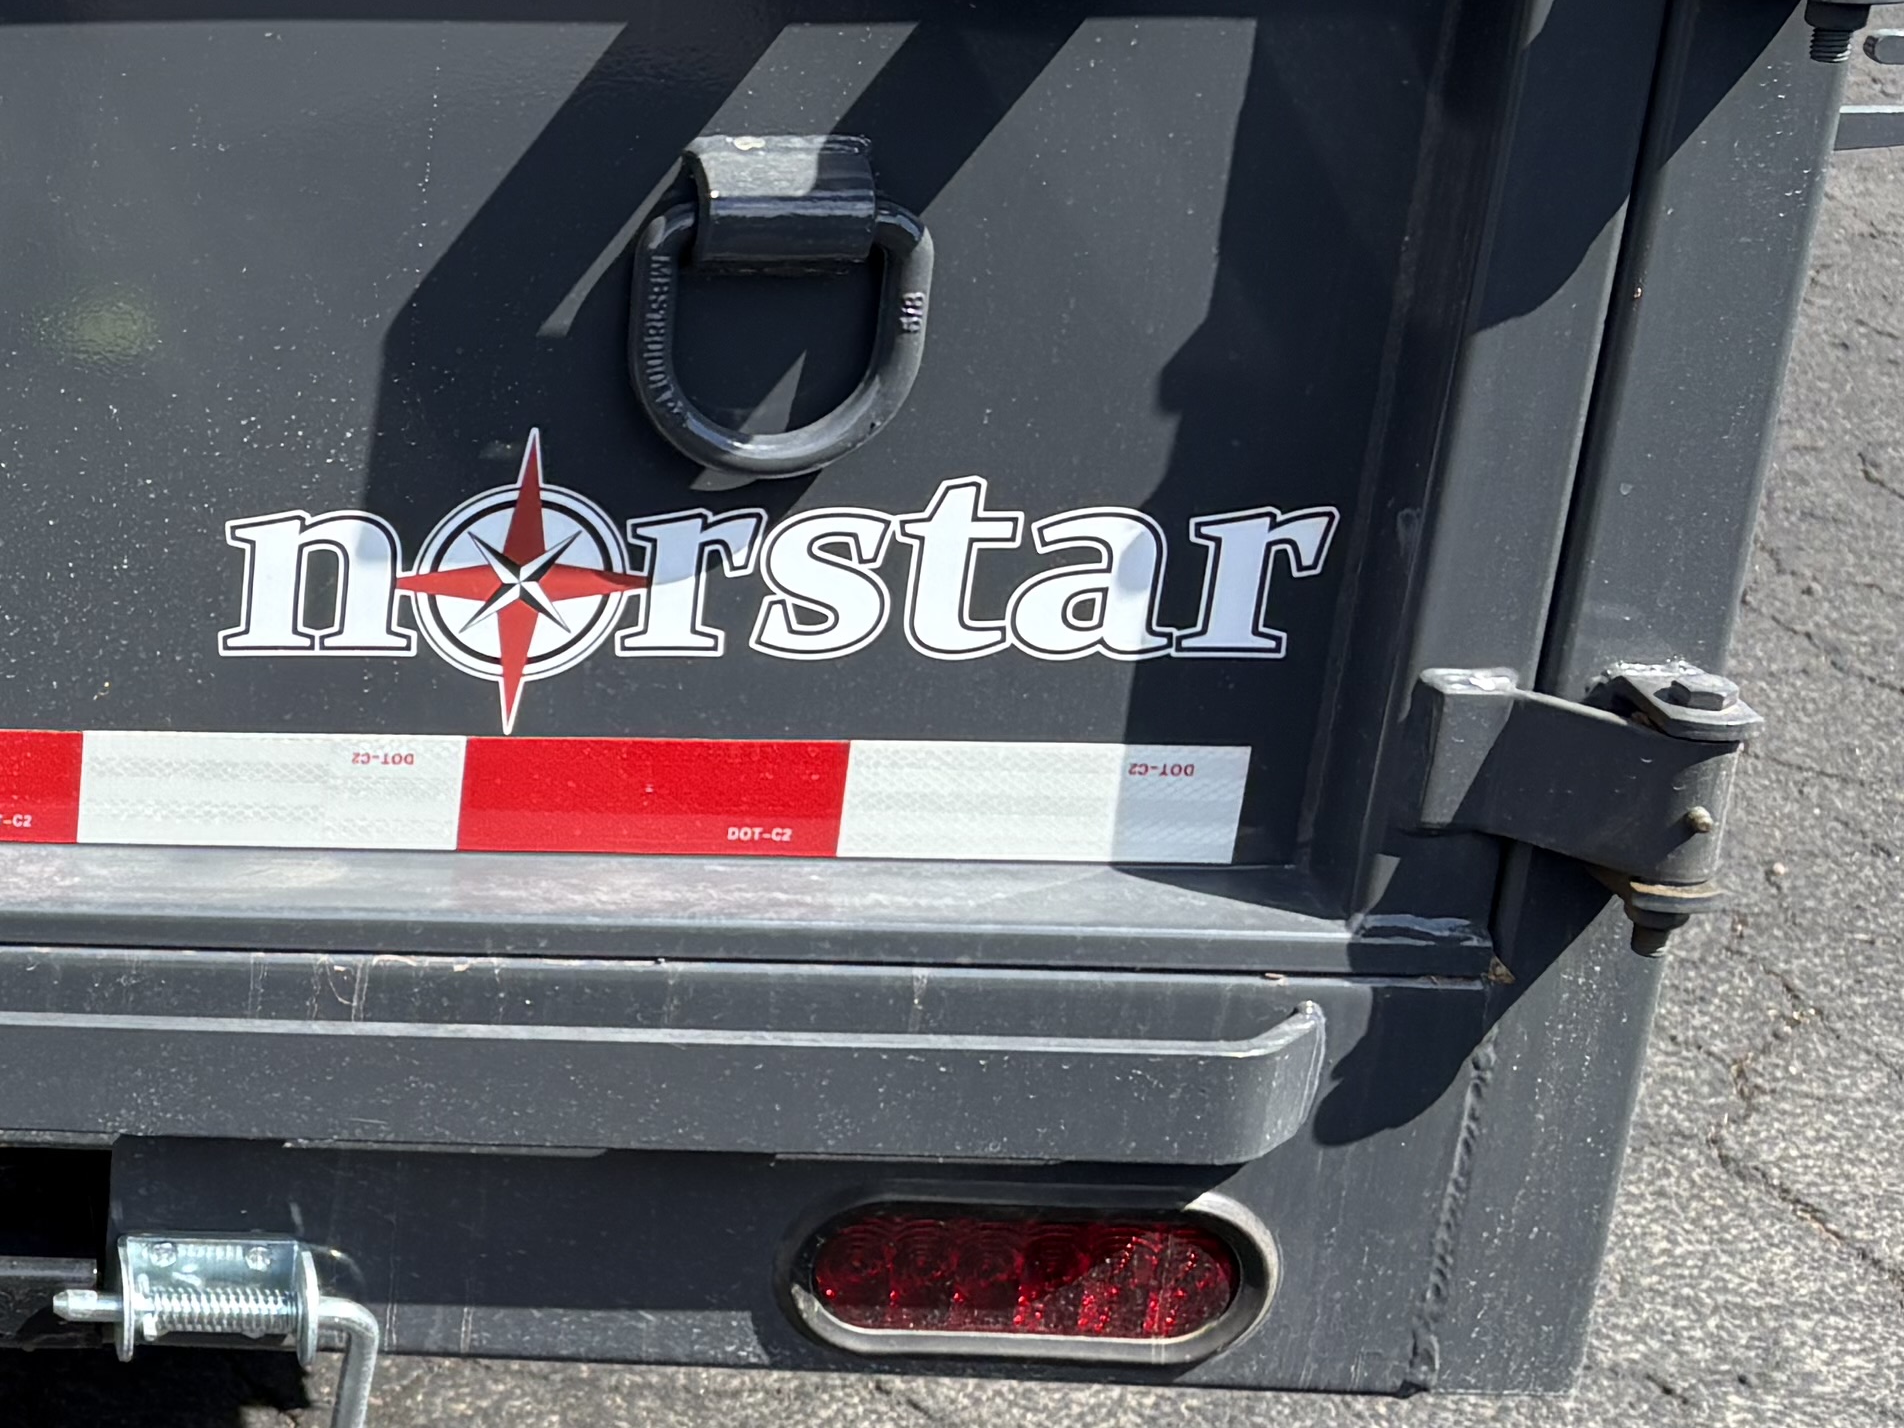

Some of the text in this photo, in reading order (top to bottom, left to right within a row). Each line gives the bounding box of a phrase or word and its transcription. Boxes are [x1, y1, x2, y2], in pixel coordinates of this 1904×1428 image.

[219, 474, 1341, 681] norstar
[351, 752, 415, 765] DOT-C2
[1127, 763, 1195, 777] DOT-C2
[727, 826, 793, 842] DOT-C2
